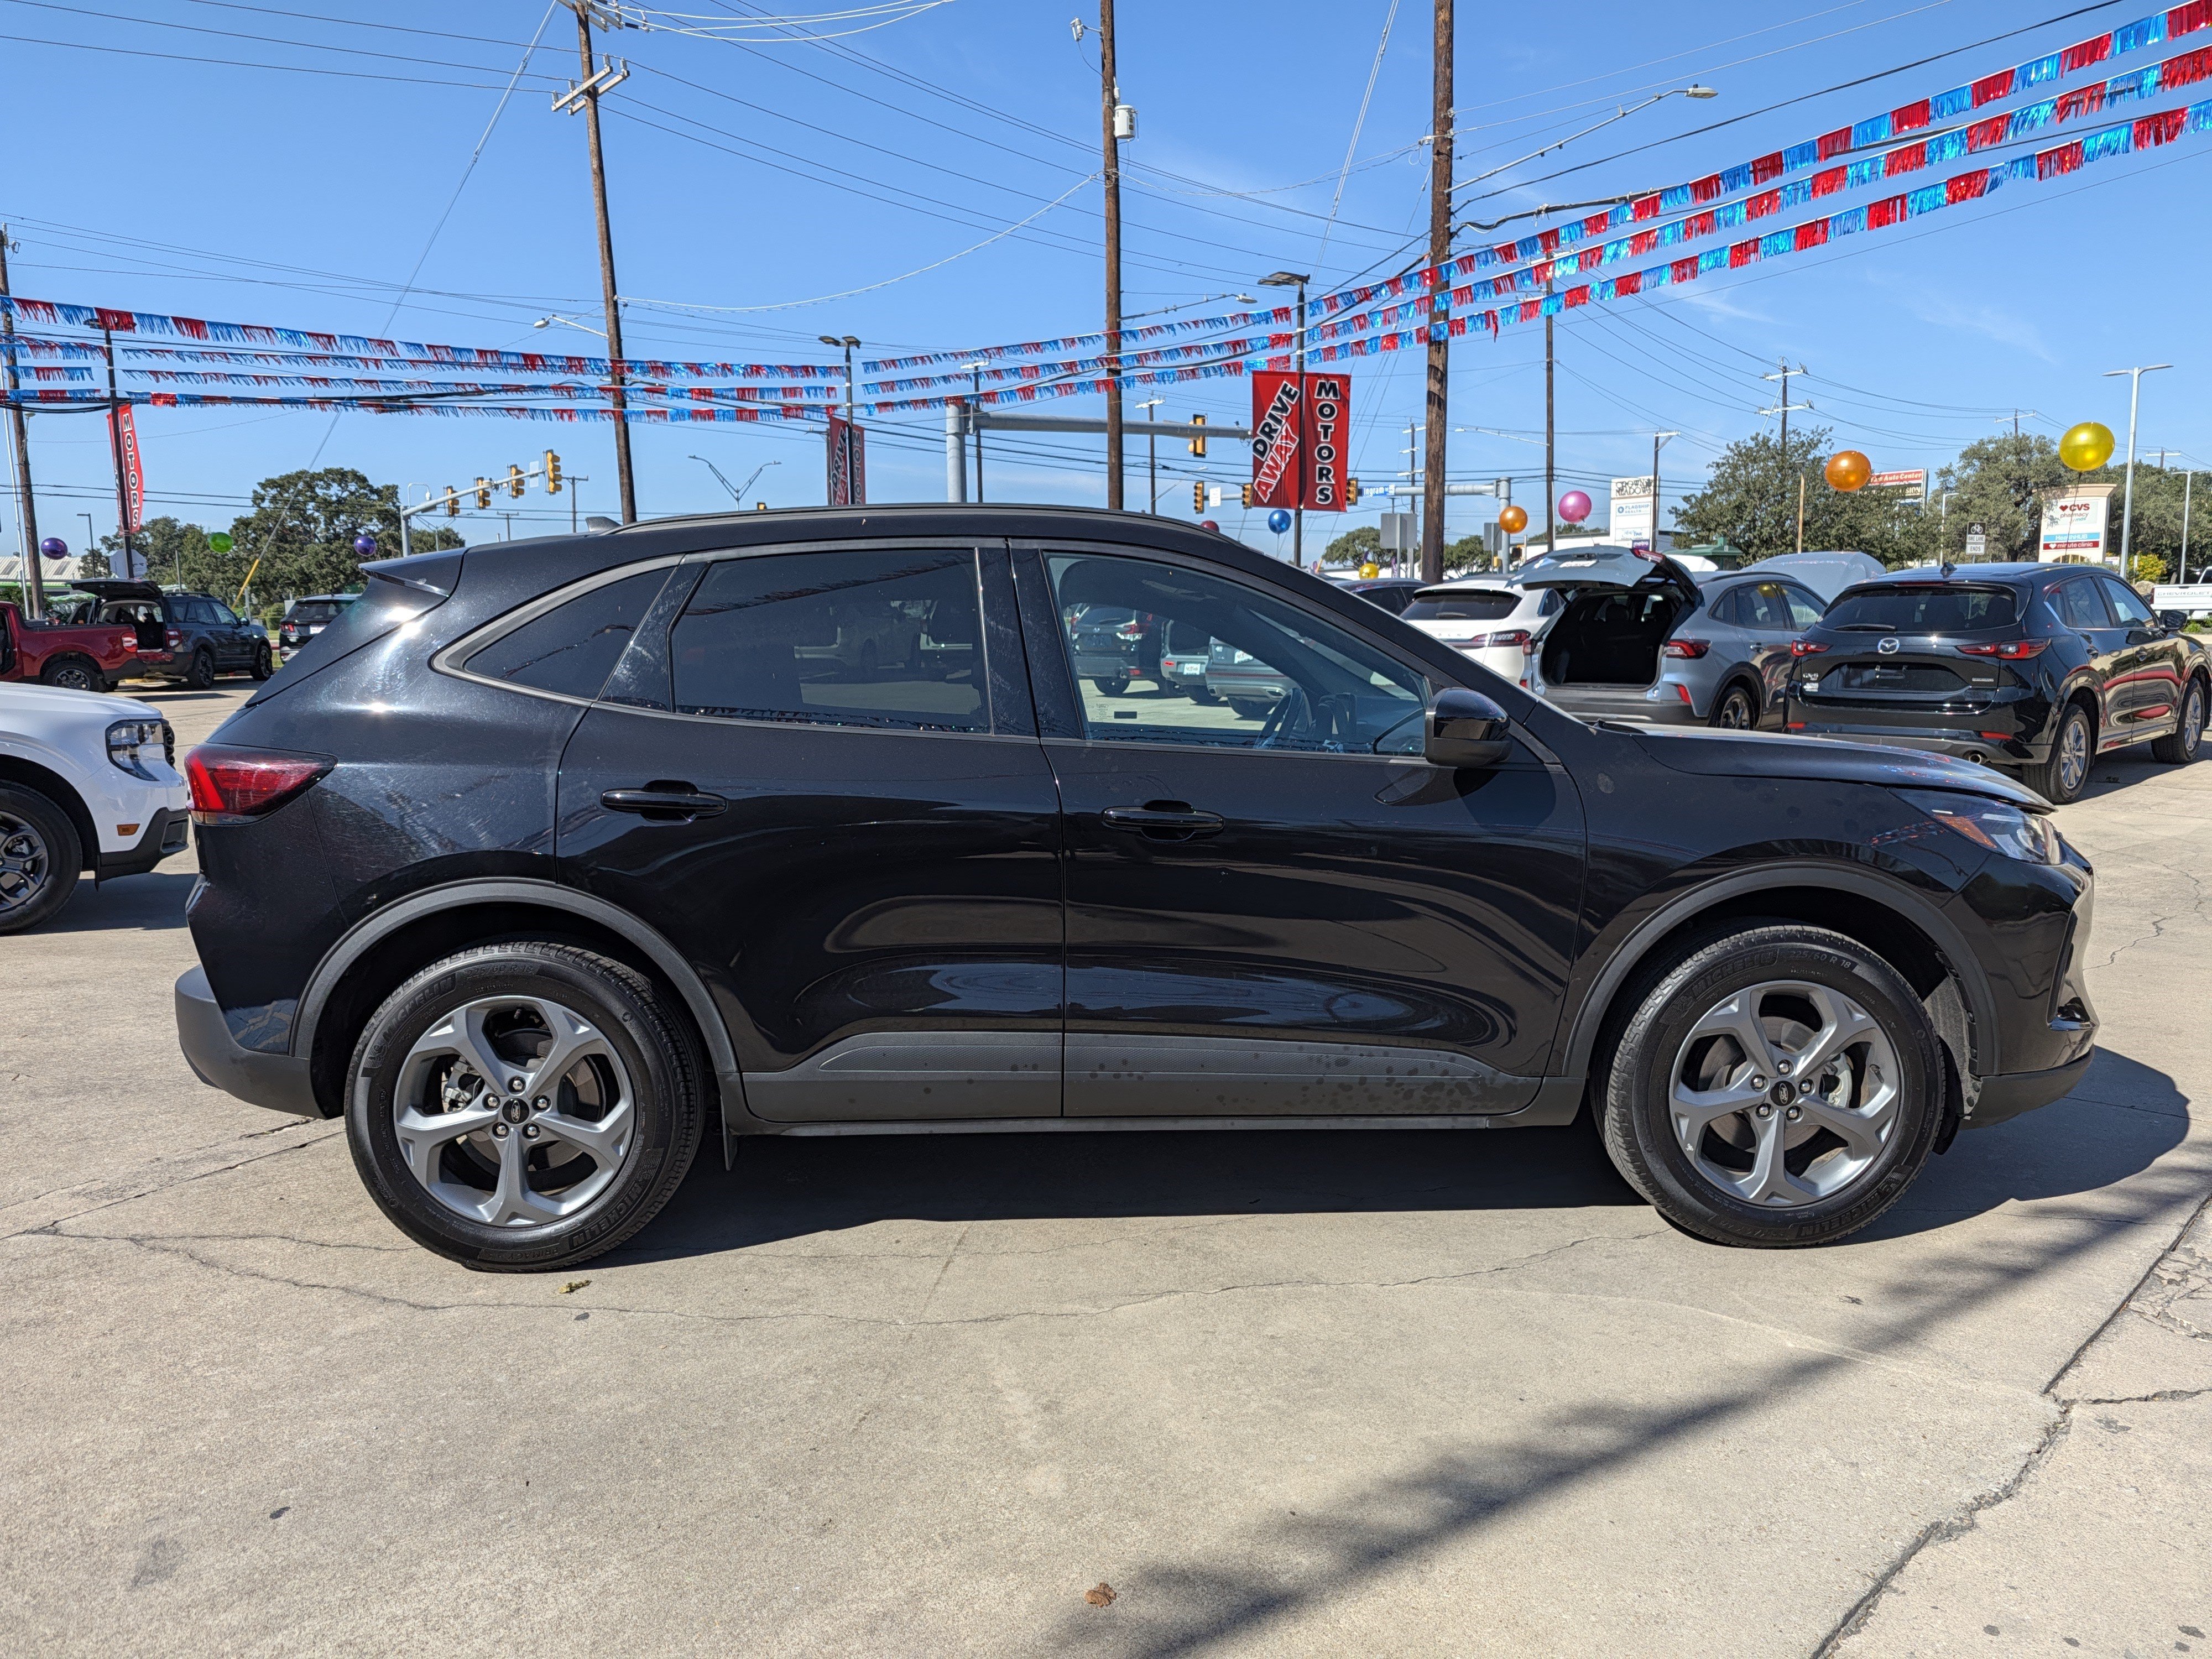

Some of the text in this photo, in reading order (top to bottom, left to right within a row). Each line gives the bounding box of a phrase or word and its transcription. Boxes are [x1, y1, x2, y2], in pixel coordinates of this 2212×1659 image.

[1253, 380, 1299, 461] DRIVE
[1314, 380, 1340, 504] MOTORS
[123, 414, 138, 526] MOTORS
[832, 426, 846, 492] DRIVE
[852, 431, 862, 504] MOTO
[1253, 422, 1299, 503] AWAY
[2069, 503, 2090, 512] CVS
[1841, 959, 1851, 968] 18
[382, 975, 453, 1041] MICHELIN
[573, 1181, 645, 1246] MICHELIN
